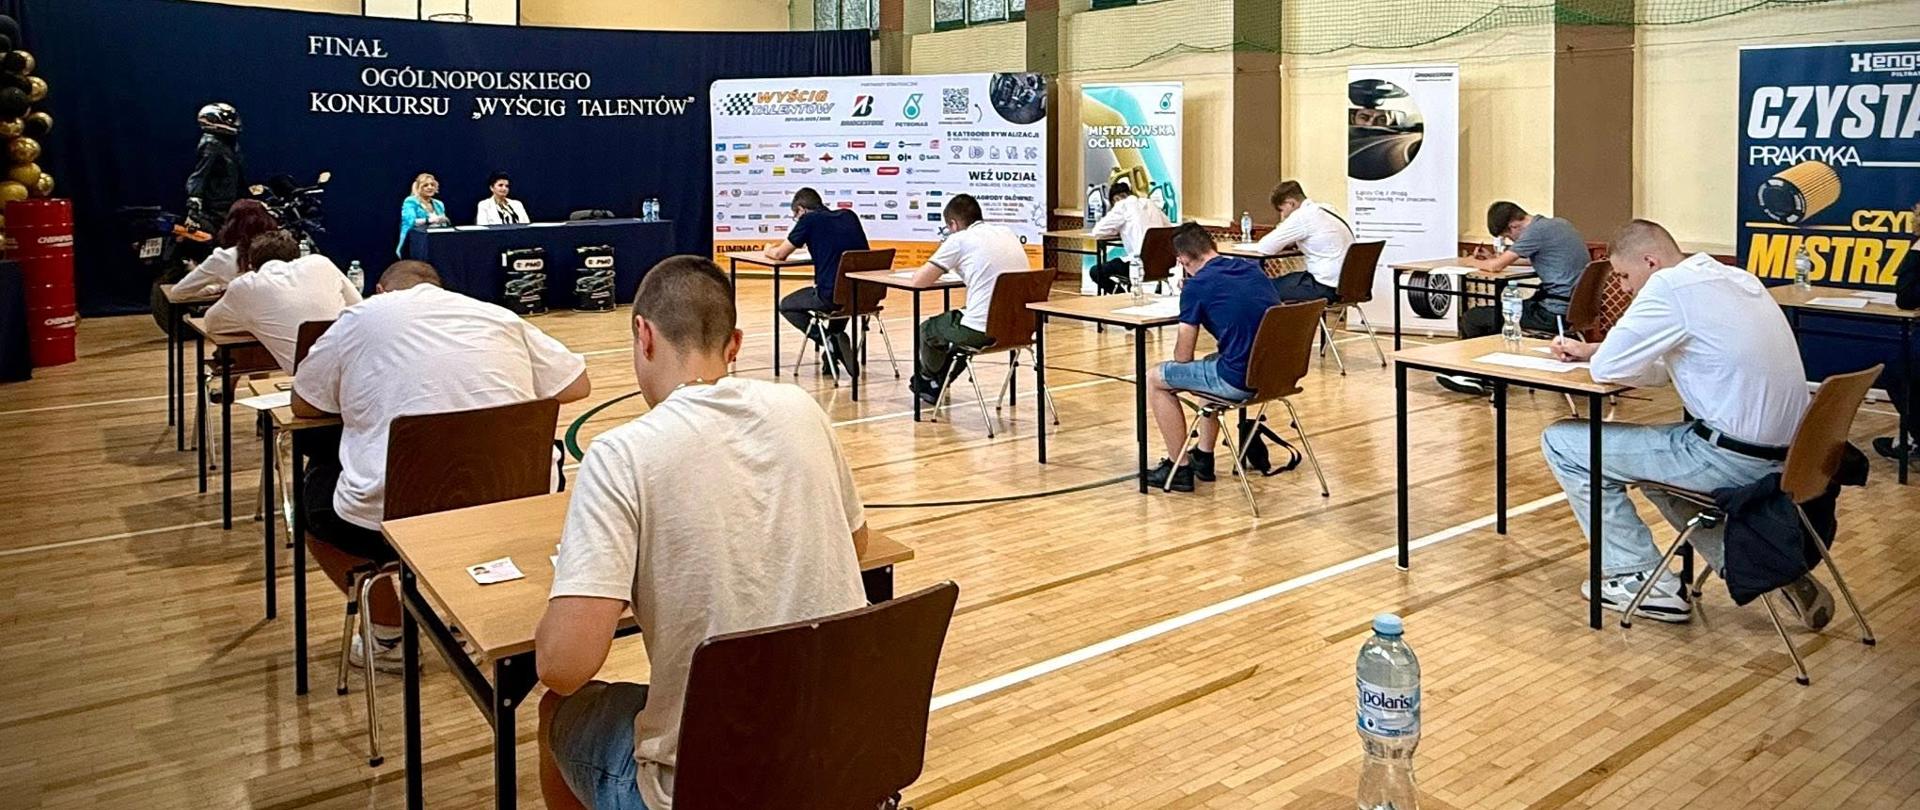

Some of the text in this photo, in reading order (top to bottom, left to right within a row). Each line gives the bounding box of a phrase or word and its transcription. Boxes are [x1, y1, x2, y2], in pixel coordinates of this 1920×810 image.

[308, 35, 389, 58] FINAŁ
[361, 66, 591, 90] OGÓLNOPOLSKIEGO
[757, 89, 829, 103] WYŚCIG
[310, 92, 695, 119] KONKURSU „WYŚCIG TALENTÓW”
[751, 102, 836, 115] TALENTÓW
[1088, 125, 1175, 136] MISTRZOWSKA
[1088, 137, 1149, 149] OCHRONA
[1750, 146, 1862, 166] PRAKTYKA
[968, 168, 1037, 181] WEŹ UDZIAŁ
[716, 244, 765, 254] ELIMINACJ
